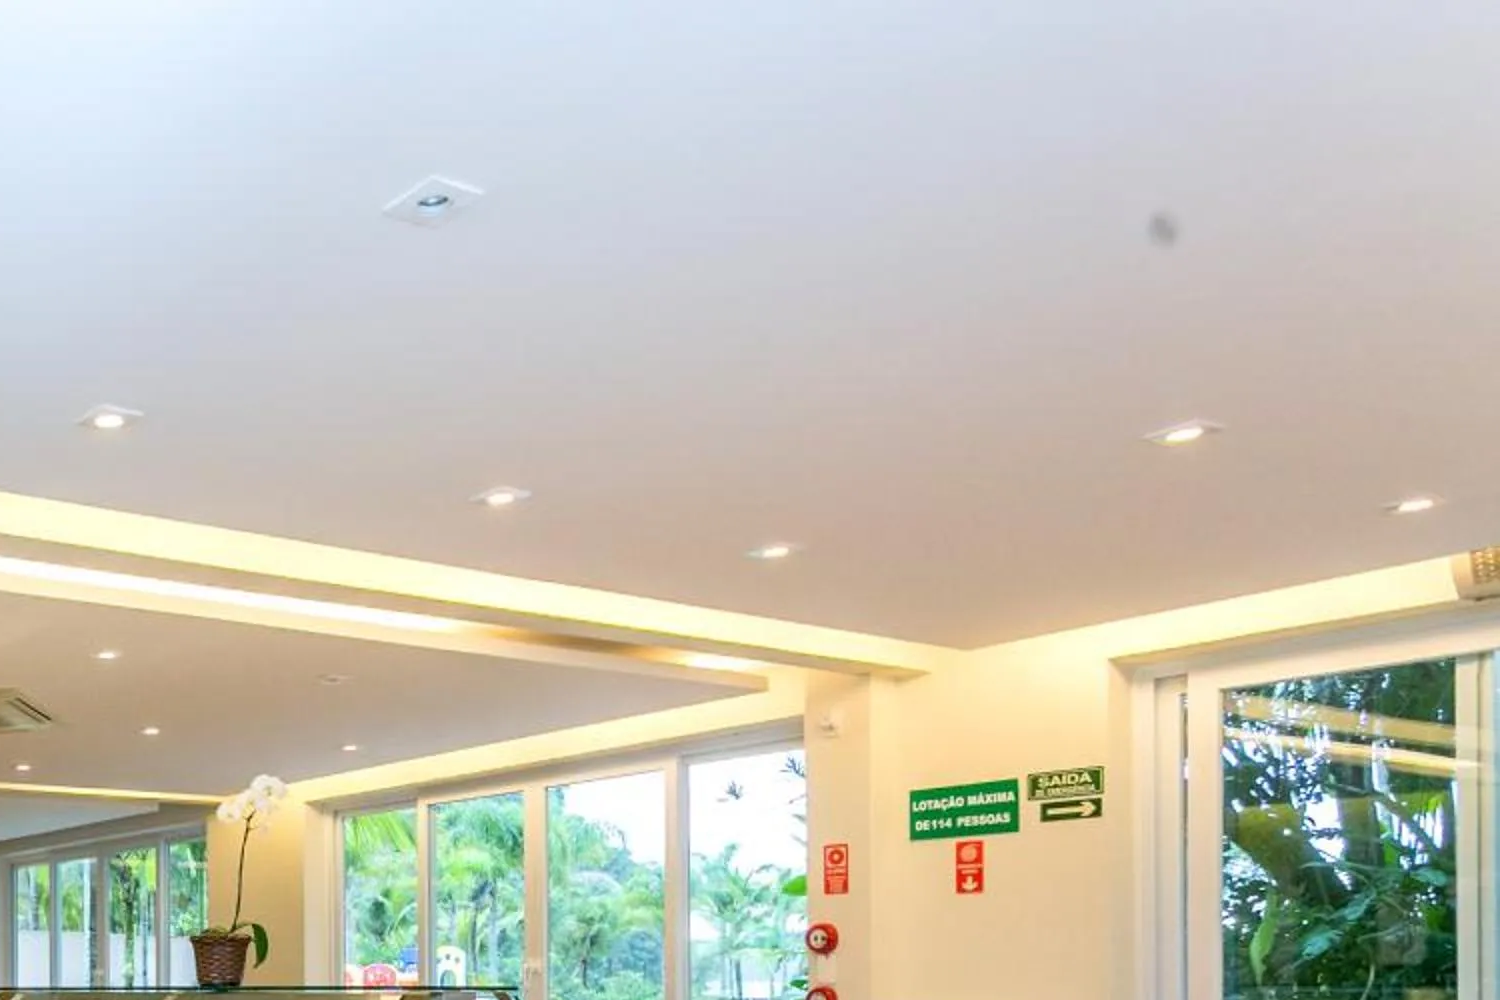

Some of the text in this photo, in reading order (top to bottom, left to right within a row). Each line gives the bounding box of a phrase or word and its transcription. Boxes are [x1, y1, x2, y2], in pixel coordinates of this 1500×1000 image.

[912, 791, 1015, 812] LOTAÇÃO MÁXIMA
[956, 812, 1010, 828] PESSOAS
